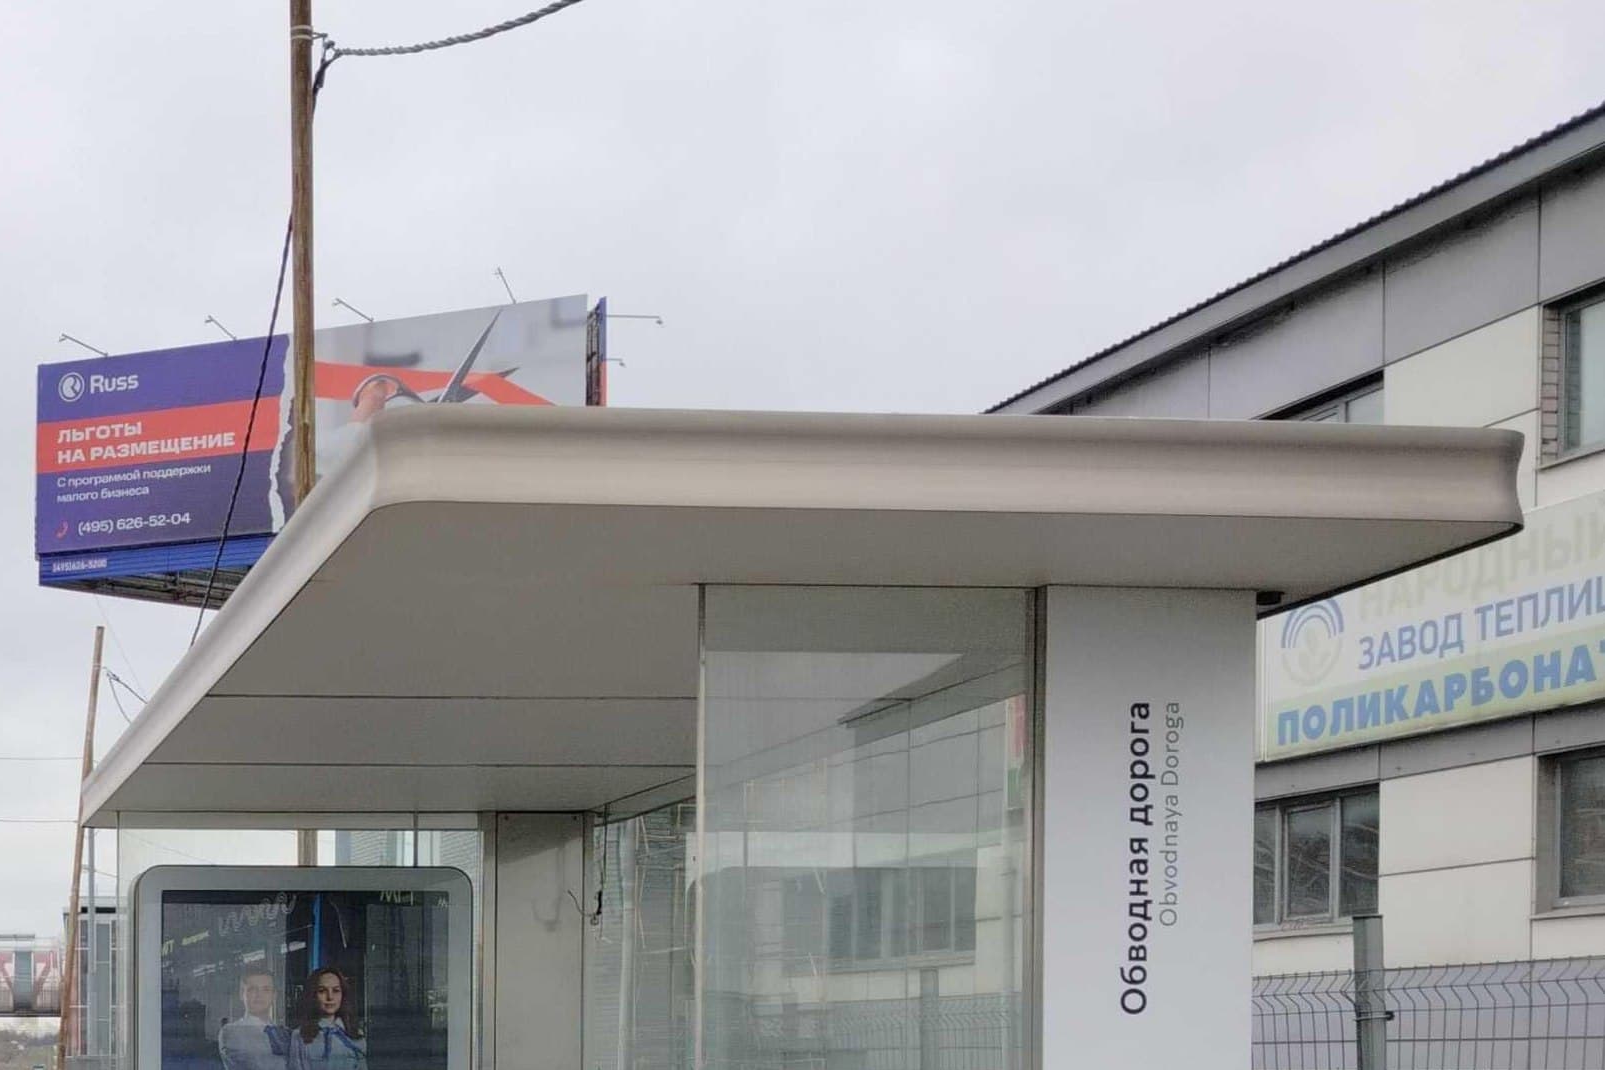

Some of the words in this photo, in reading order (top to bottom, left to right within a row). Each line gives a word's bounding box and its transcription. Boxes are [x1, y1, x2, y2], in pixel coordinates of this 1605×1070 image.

[90, 375, 139, 394] Russ
[57, 422, 142, 444] ЛЬГОТЫ
[57, 450, 85, 464] НА
[90, 432, 235, 461] РАЗМЕЩЕНИЕ
[57, 477, 66, 488] С
[68, 469, 141, 489] программой
[143, 464, 212, 480] поддержки
[57, 491, 99, 503] малого
[101, 485, 150, 500] бизнеса
[78, 518, 114, 537] (495)
[116, 512, 192, 531] 626-52-04
[1358, 612, 1465, 671] ЗАВОД
[1160, 702, 1184, 786] Doroga
[1129, 702, 1155, 826] дорога
[1159, 794, 1183, 926] Obvodnaya
[1120, 837, 1152, 1015] Обводная
